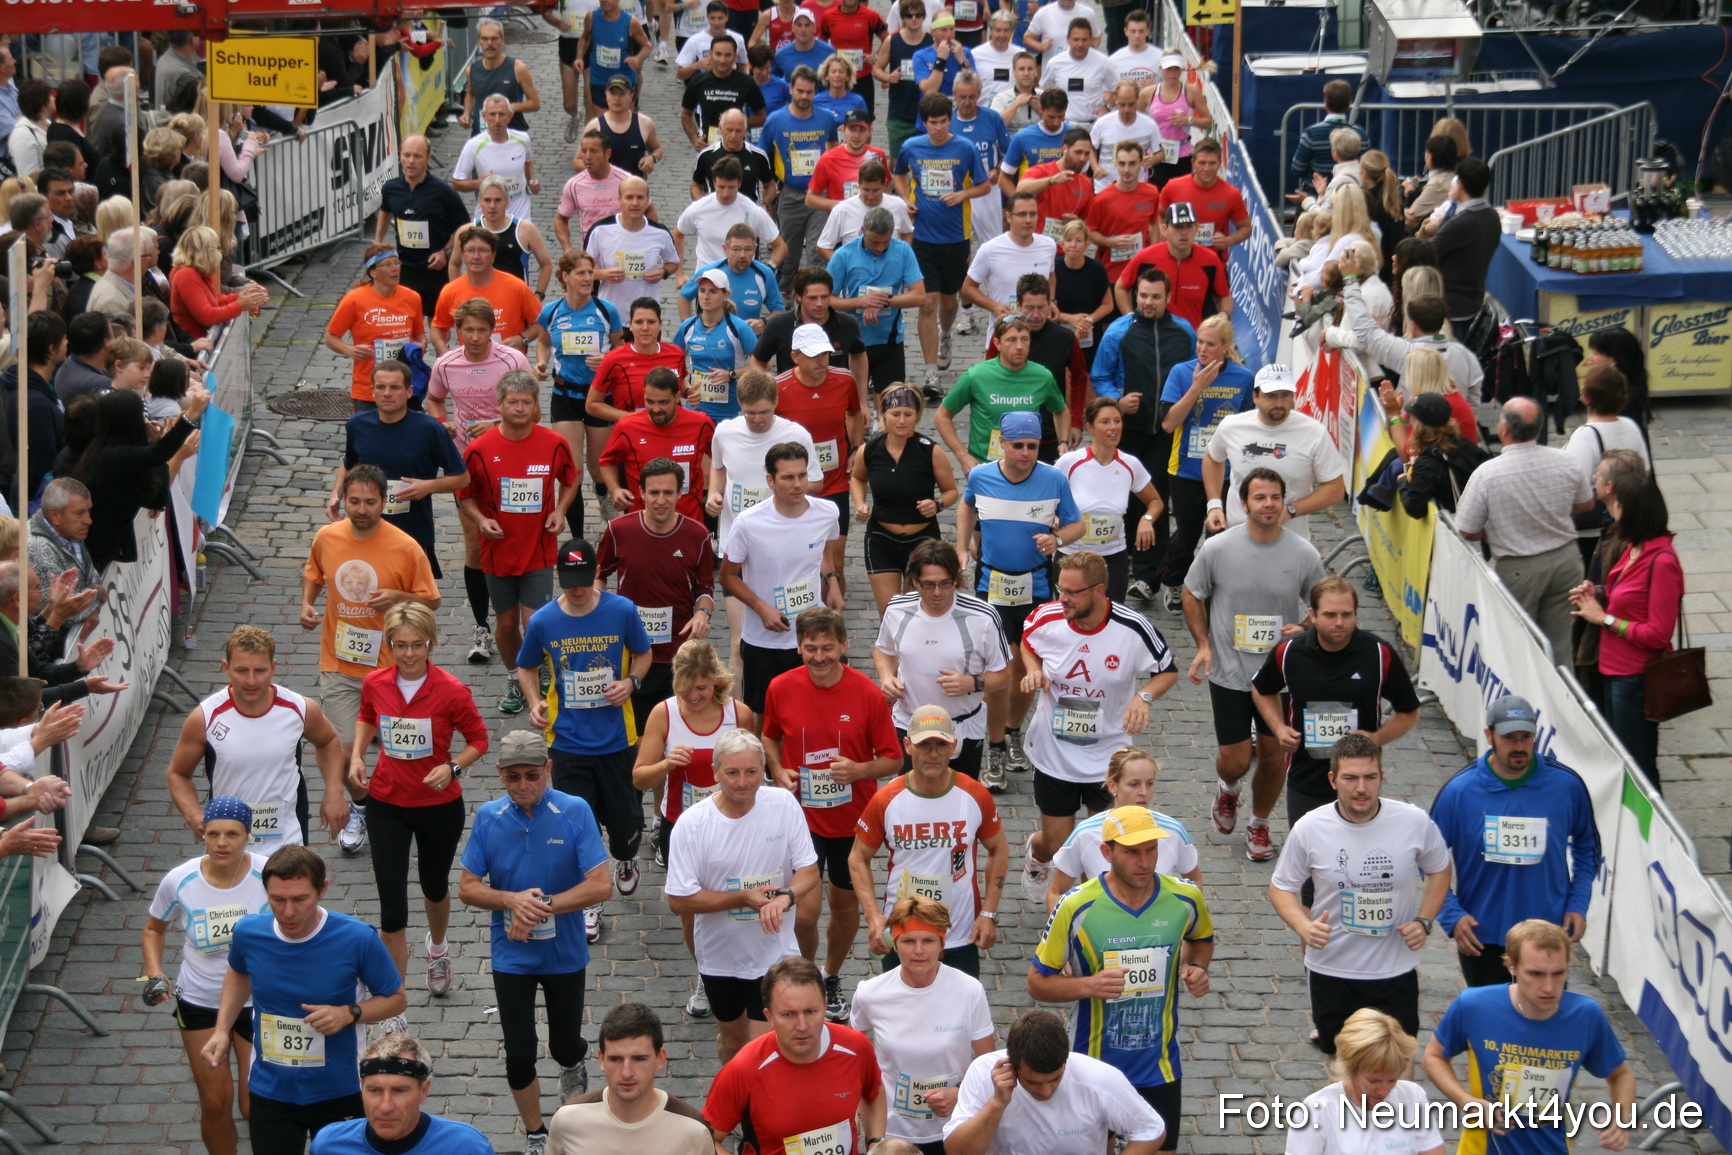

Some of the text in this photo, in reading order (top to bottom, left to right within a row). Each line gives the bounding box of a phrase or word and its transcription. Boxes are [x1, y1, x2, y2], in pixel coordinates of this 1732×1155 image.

[216, 51, 309, 70] Schnupper-
[248, 73, 278, 87] lauf
[407, 232, 423, 240] 978
[628, 263, 646, 271] 725
[372, 312, 408, 323] Fischer
[1650, 307, 1732, 349] Glossner
[575, 336, 593, 344] 522
[1692, 329, 1730, 346] Bier
[702, 384, 725, 393] 1069
[990, 394, 1034, 407] Sinupret
[673, 445, 695, 453] JURA
[512, 492, 540, 502] 2076
[743, 488, 760, 497] Daniel
[1092, 518, 1107, 526] Birgit
[1095, 526, 1115, 537] 657
[1000, 577, 1017, 585] Edgar
[787, 583, 807, 594] Michael
[1004, 587, 1026, 596] 967
[789, 592, 815, 607] 3053
[640, 610, 667, 619] Christoph
[1248, 618, 1276, 627] Christian
[550, 635, 619, 648] 10. NEUMARKTER
[1252, 631, 1275, 641] 475
[348, 640, 372, 653] 332
[560, 644, 608, 654] STADTLAUF
[577, 673, 607, 682] Alexander
[1052, 680, 1106, 699] AREVA
[1067, 710, 1097, 720] Alexander
[1318, 714, 1347, 722] Wolfgang
[1067, 722, 1096, 733] 2704
[1319, 725, 1351, 737] 3342
[395, 733, 426, 745] 2470
[812, 773, 832, 782] Wolfg
[814, 783, 845, 795] 2580
[250, 806, 278, 815] exander
[1501, 820, 1525, 830] Marco
[893, 820, 967, 842] MERZ
[893, 834, 952, 850] Reisen
[1502, 835, 1537, 847] 3311
[743, 879, 771, 890] Herbert
[911, 876, 939, 886] Thomas
[1338, 881, 1349, 889] 9.
[1357, 896, 1392, 905] Sebastian
[209, 908, 248, 920] Christiane
[1358, 908, 1393, 920] 3103
[1107, 936, 1136, 944] TEAM
[1121, 955, 1150, 965] Helmut
[1129, 968, 1157, 984] 608
[277, 1020, 301, 1032] Georg
[283, 1036, 313, 1050] 837
[1483, 1039, 1580, 1060] 10. NEUMARKTER
[1498, 1053, 1566, 1070] STADTLAUF
[1523, 1070, 1545, 1081] Sven
[913, 1080, 948, 1091] Marianne
[803, 1134, 833, 1148] Martin
